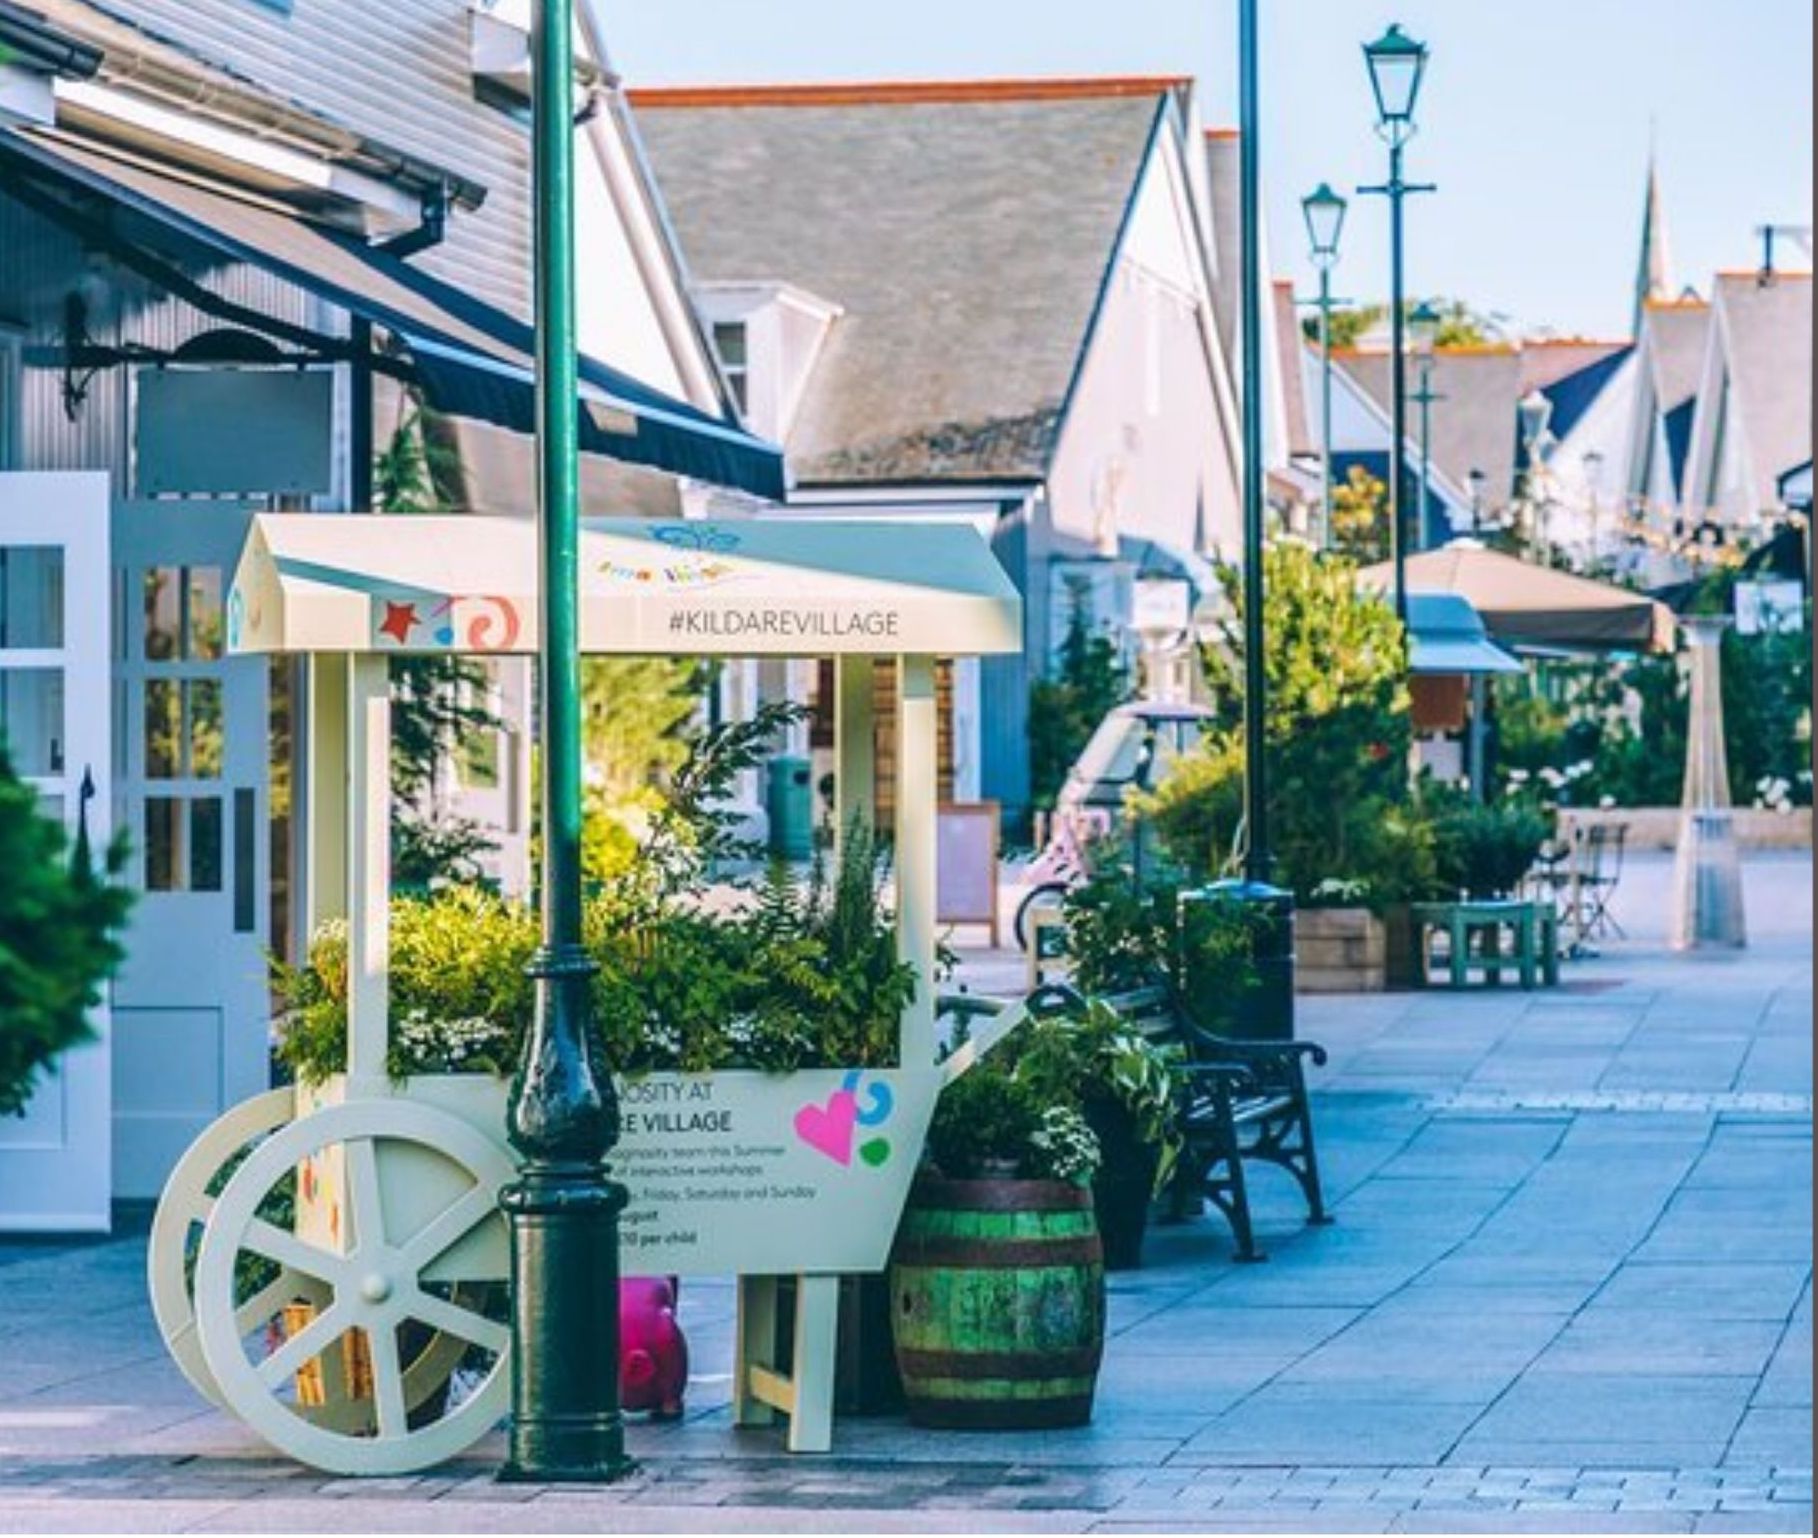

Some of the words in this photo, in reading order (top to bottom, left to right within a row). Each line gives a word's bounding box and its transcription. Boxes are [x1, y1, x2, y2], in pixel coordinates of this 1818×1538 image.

[669, 610, 898, 636] #KILDAREVILLAGE
[689, 1081, 714, 1101] AT
[642, 1110, 733, 1133] VILLAGE
[684, 1186, 741, 1202] Saturday
[744, 1185, 767, 1199] and
[770, 1185, 817, 1201] Sunday
[620, 1209, 659, 1226] ugust
[640, 1234, 661, 1249] per
[664, 1229, 697, 1244] child
